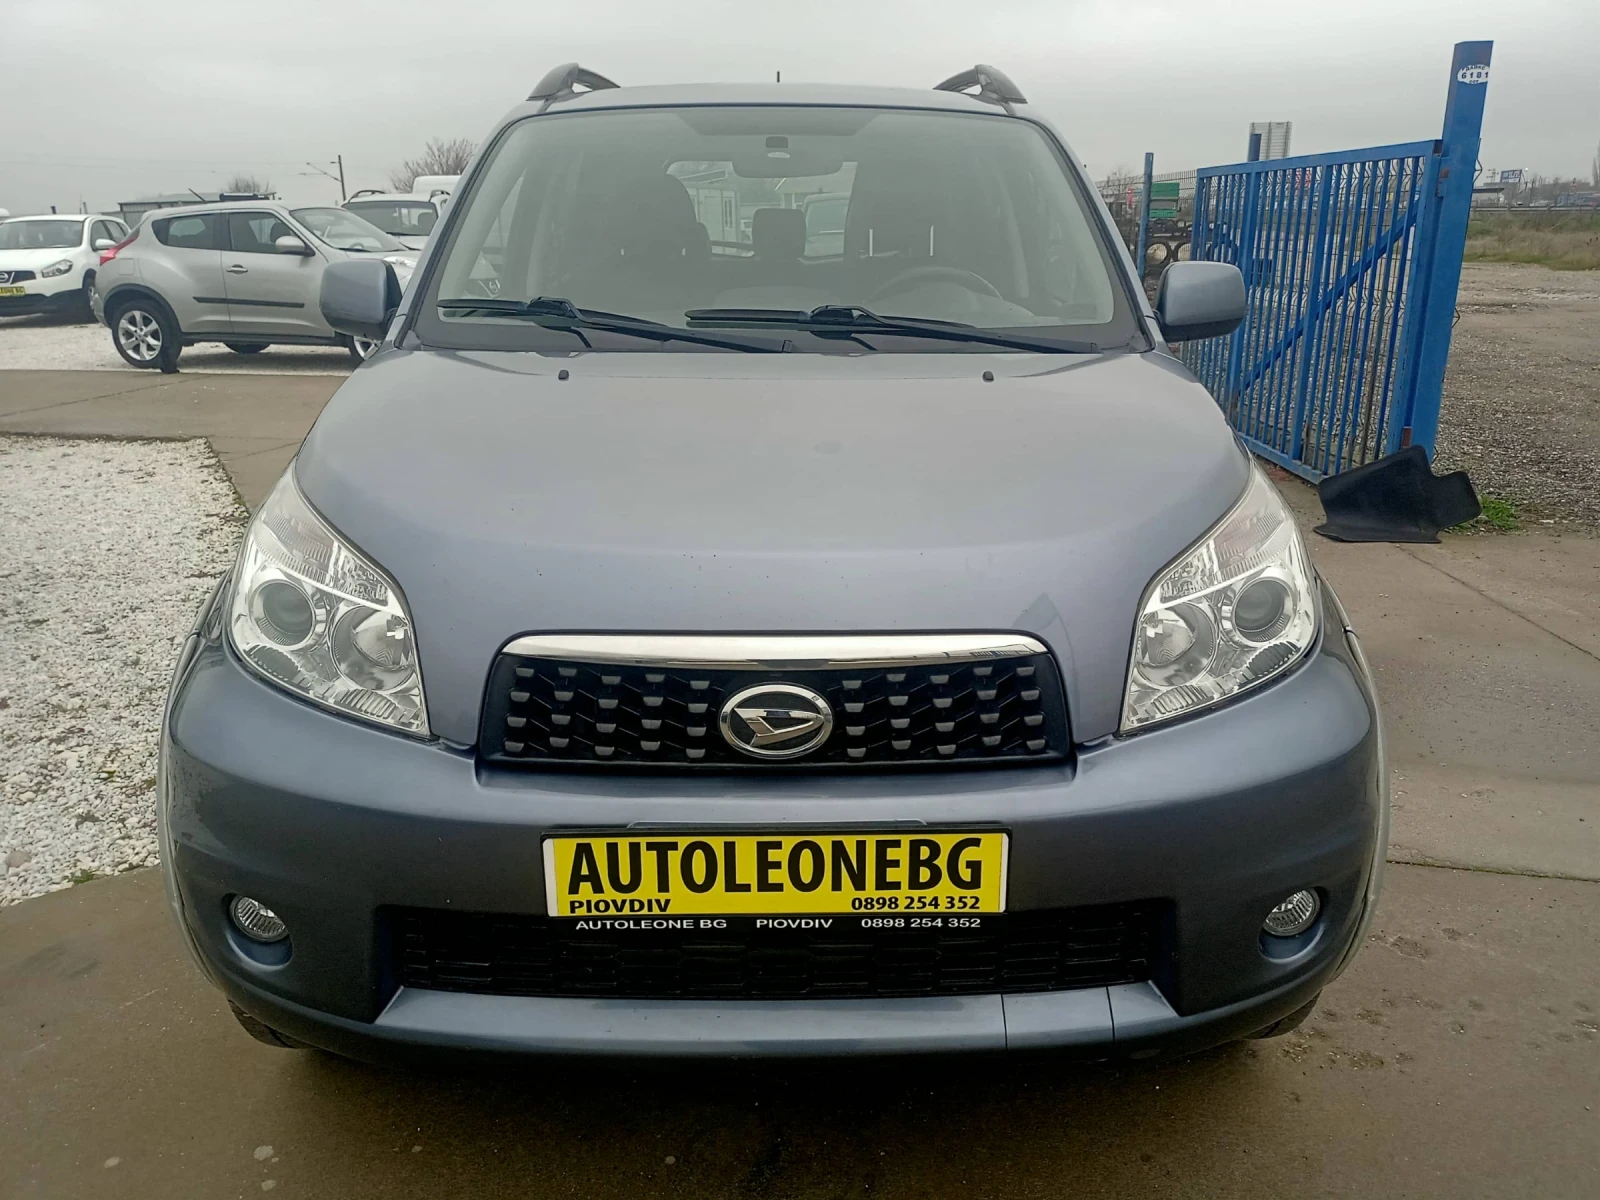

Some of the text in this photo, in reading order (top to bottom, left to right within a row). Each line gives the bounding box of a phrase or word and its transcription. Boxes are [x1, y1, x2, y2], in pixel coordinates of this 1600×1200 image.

[568, 837, 983, 895] AUTOLEONEBG
[569, 898, 671, 914] PIOVDIV
[851, 895, 980, 911] 0898 254 352
[575, 917, 981, 930] AUTOLEONE BG PIOVDIV 0898 254 352
